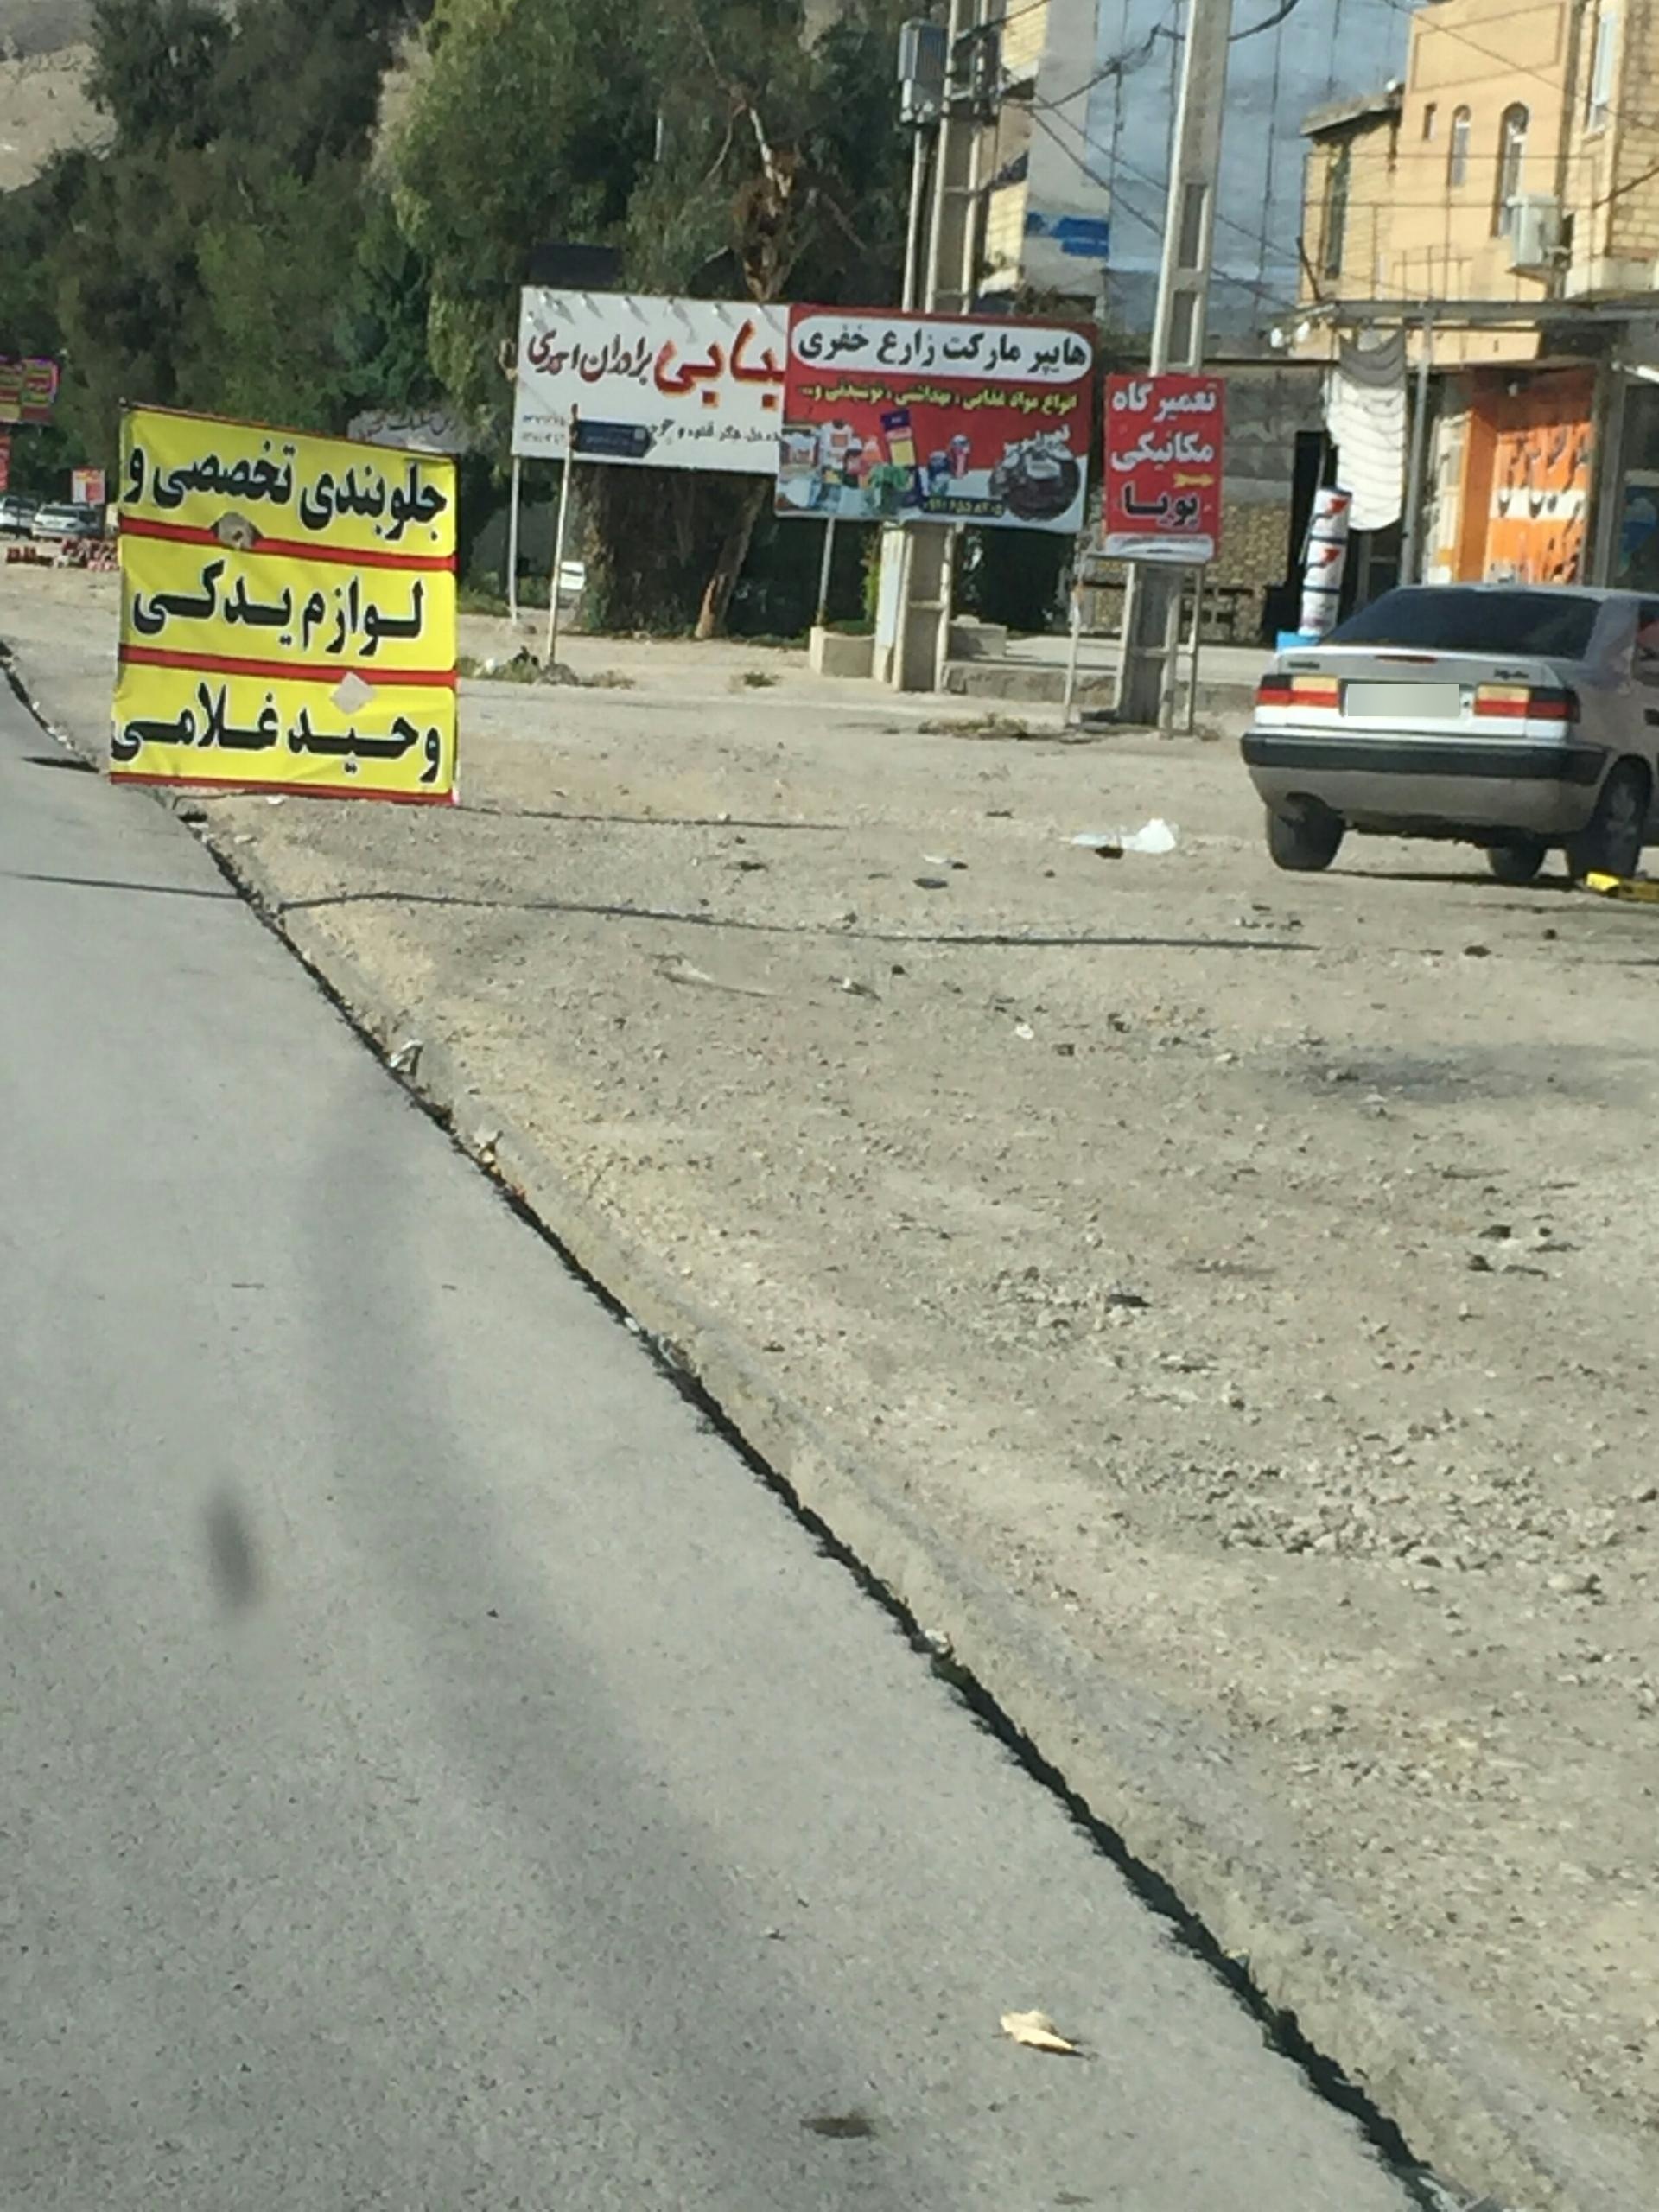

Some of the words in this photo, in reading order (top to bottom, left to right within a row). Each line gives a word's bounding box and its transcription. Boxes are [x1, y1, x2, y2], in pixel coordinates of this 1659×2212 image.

[653, 319, 785, 410] بابی
[798, 324, 870, 361] خفری
[875, 327, 936, 367] زارع
[942, 331, 1021, 371] مارکت
[1027, 336, 1086, 375] هایپر
[123, 447, 145, 504] و
[152, 439, 296, 508] تخصصی
[1110, 430, 1215, 472] مکانیکی
[133, 559, 292, 646] یدکی
[302, 575, 424, 657] لوازم
[111, 682, 281, 762] غلامی
[287, 706, 442, 784] وحید
